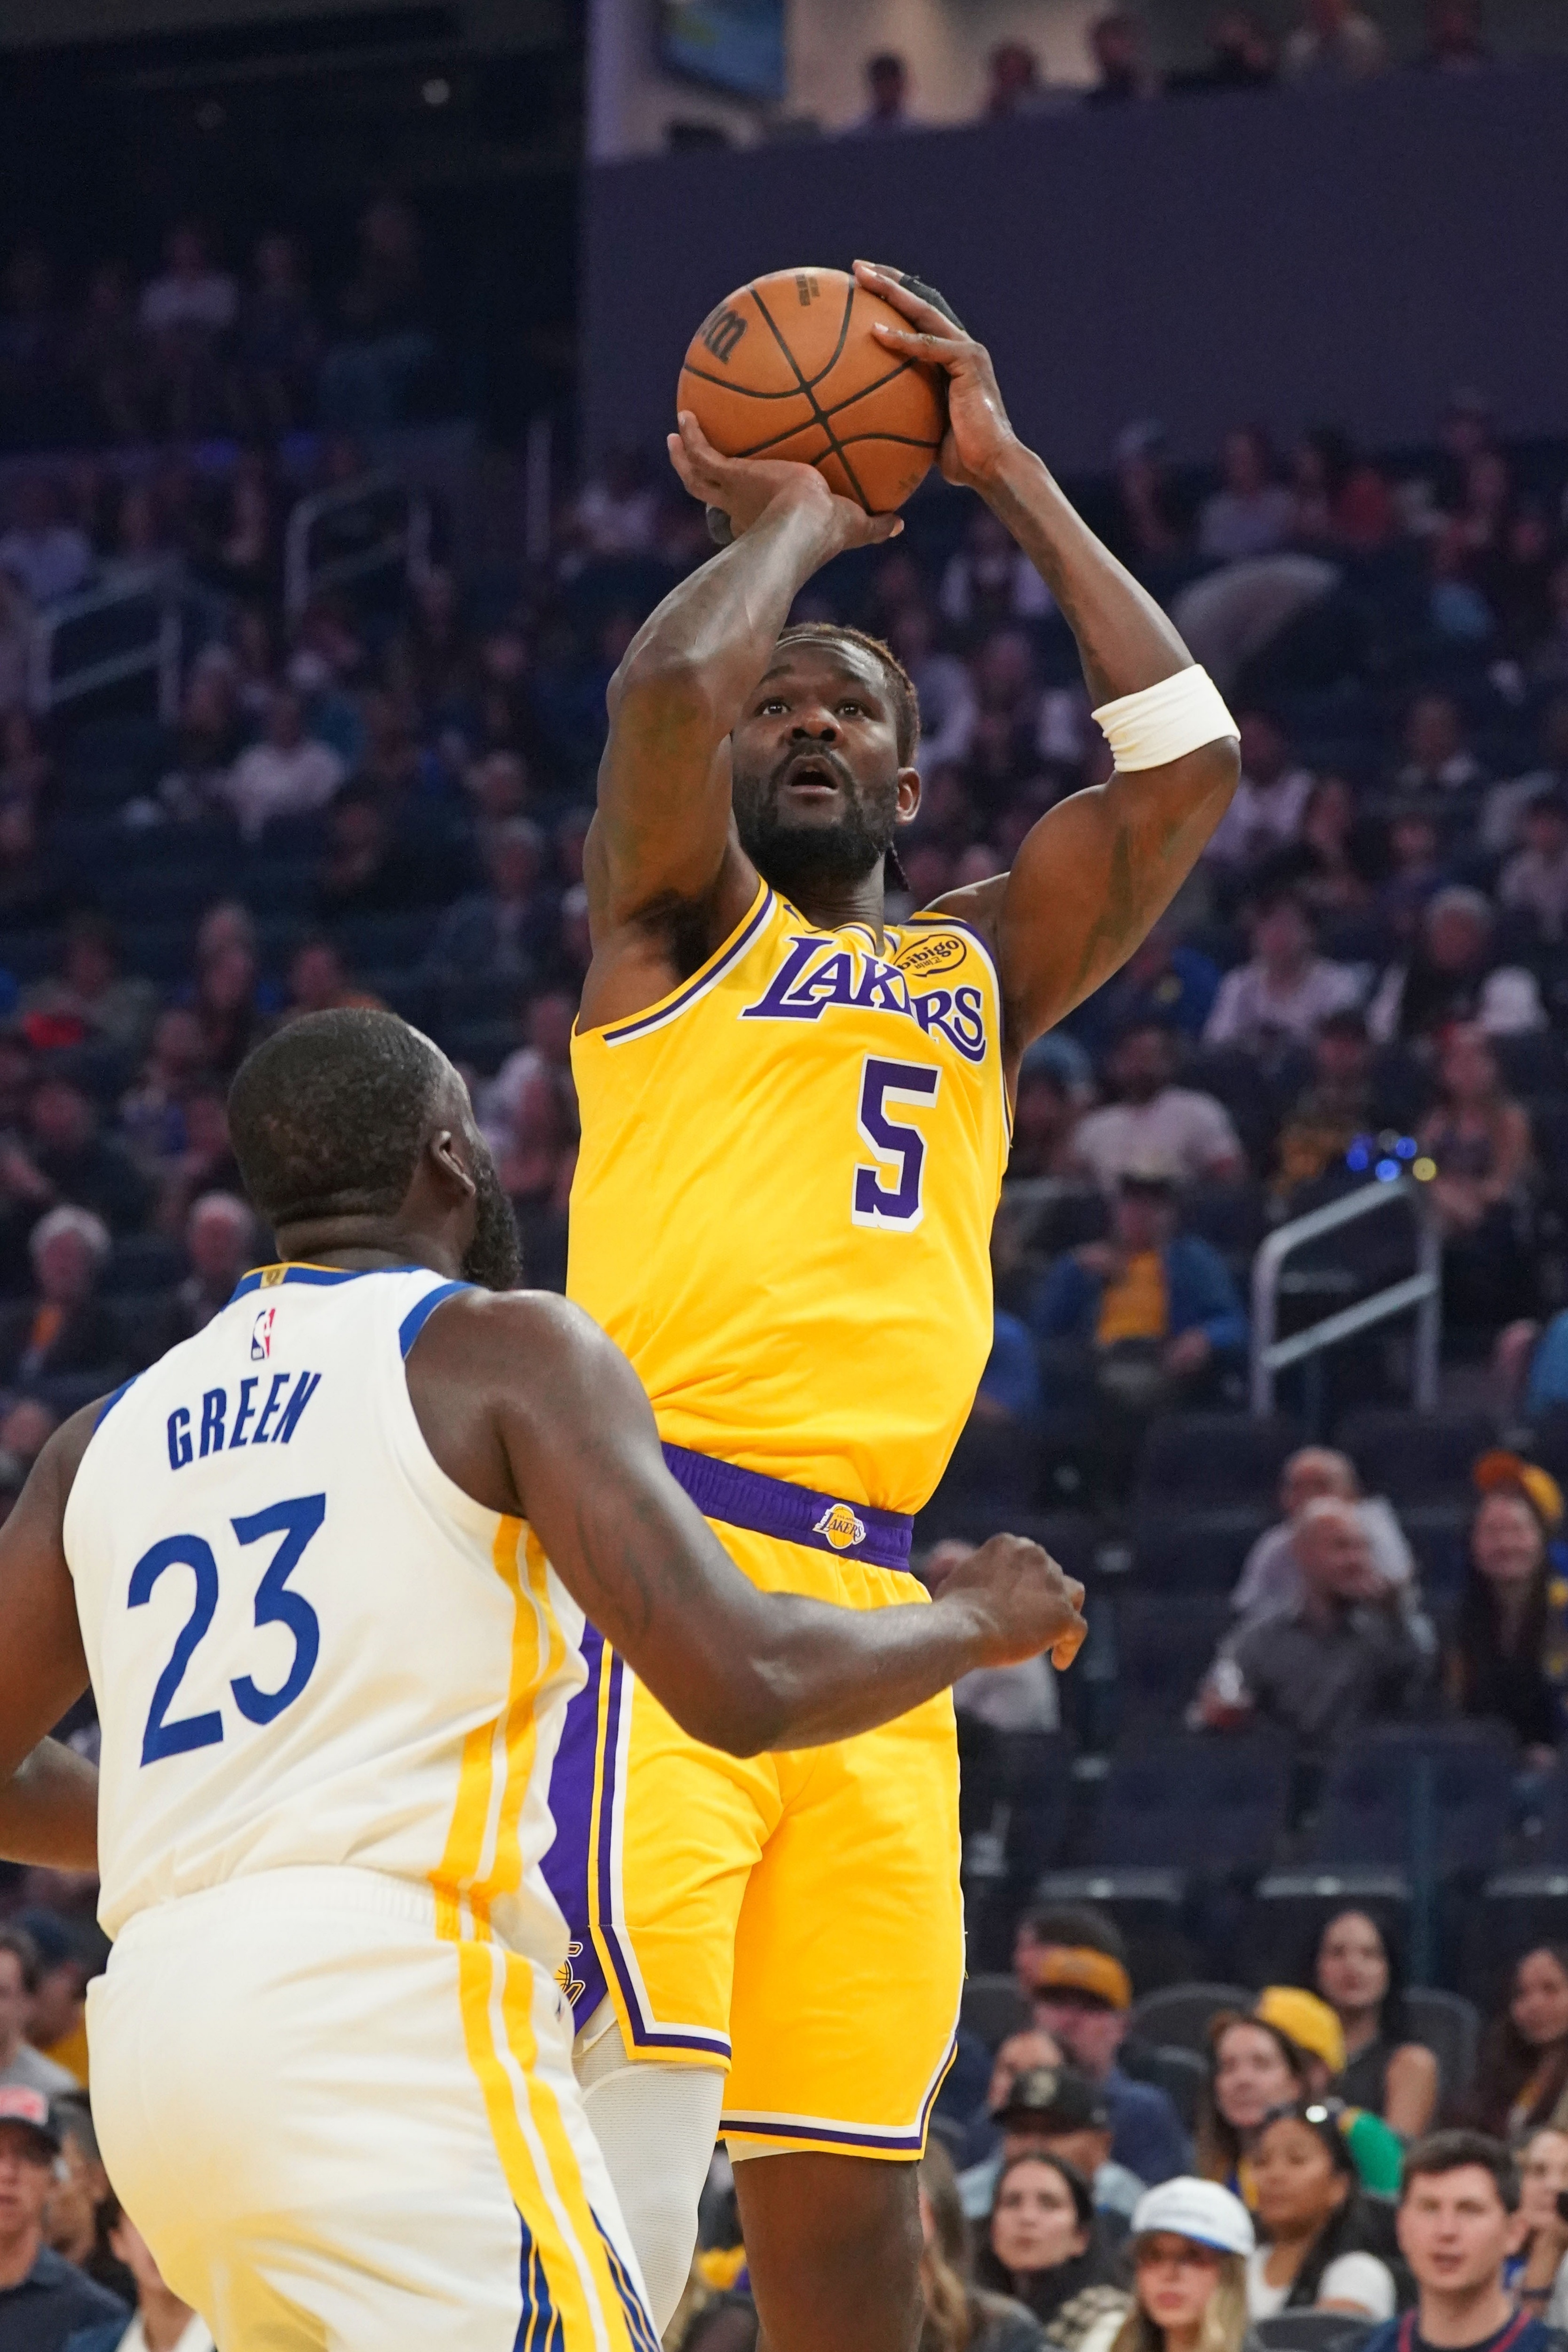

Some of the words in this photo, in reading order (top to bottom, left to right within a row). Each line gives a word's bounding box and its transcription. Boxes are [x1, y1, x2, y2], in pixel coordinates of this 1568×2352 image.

[738, 935, 987, 1065] LAKRS
[896, 940, 959, 970] bibigo
[852, 1053, 942, 1233] 5
[167, 1371, 322, 1471] GREEN
[816, 1511, 864, 1543] LAKERS
[127, 1491, 326, 1769] 23
